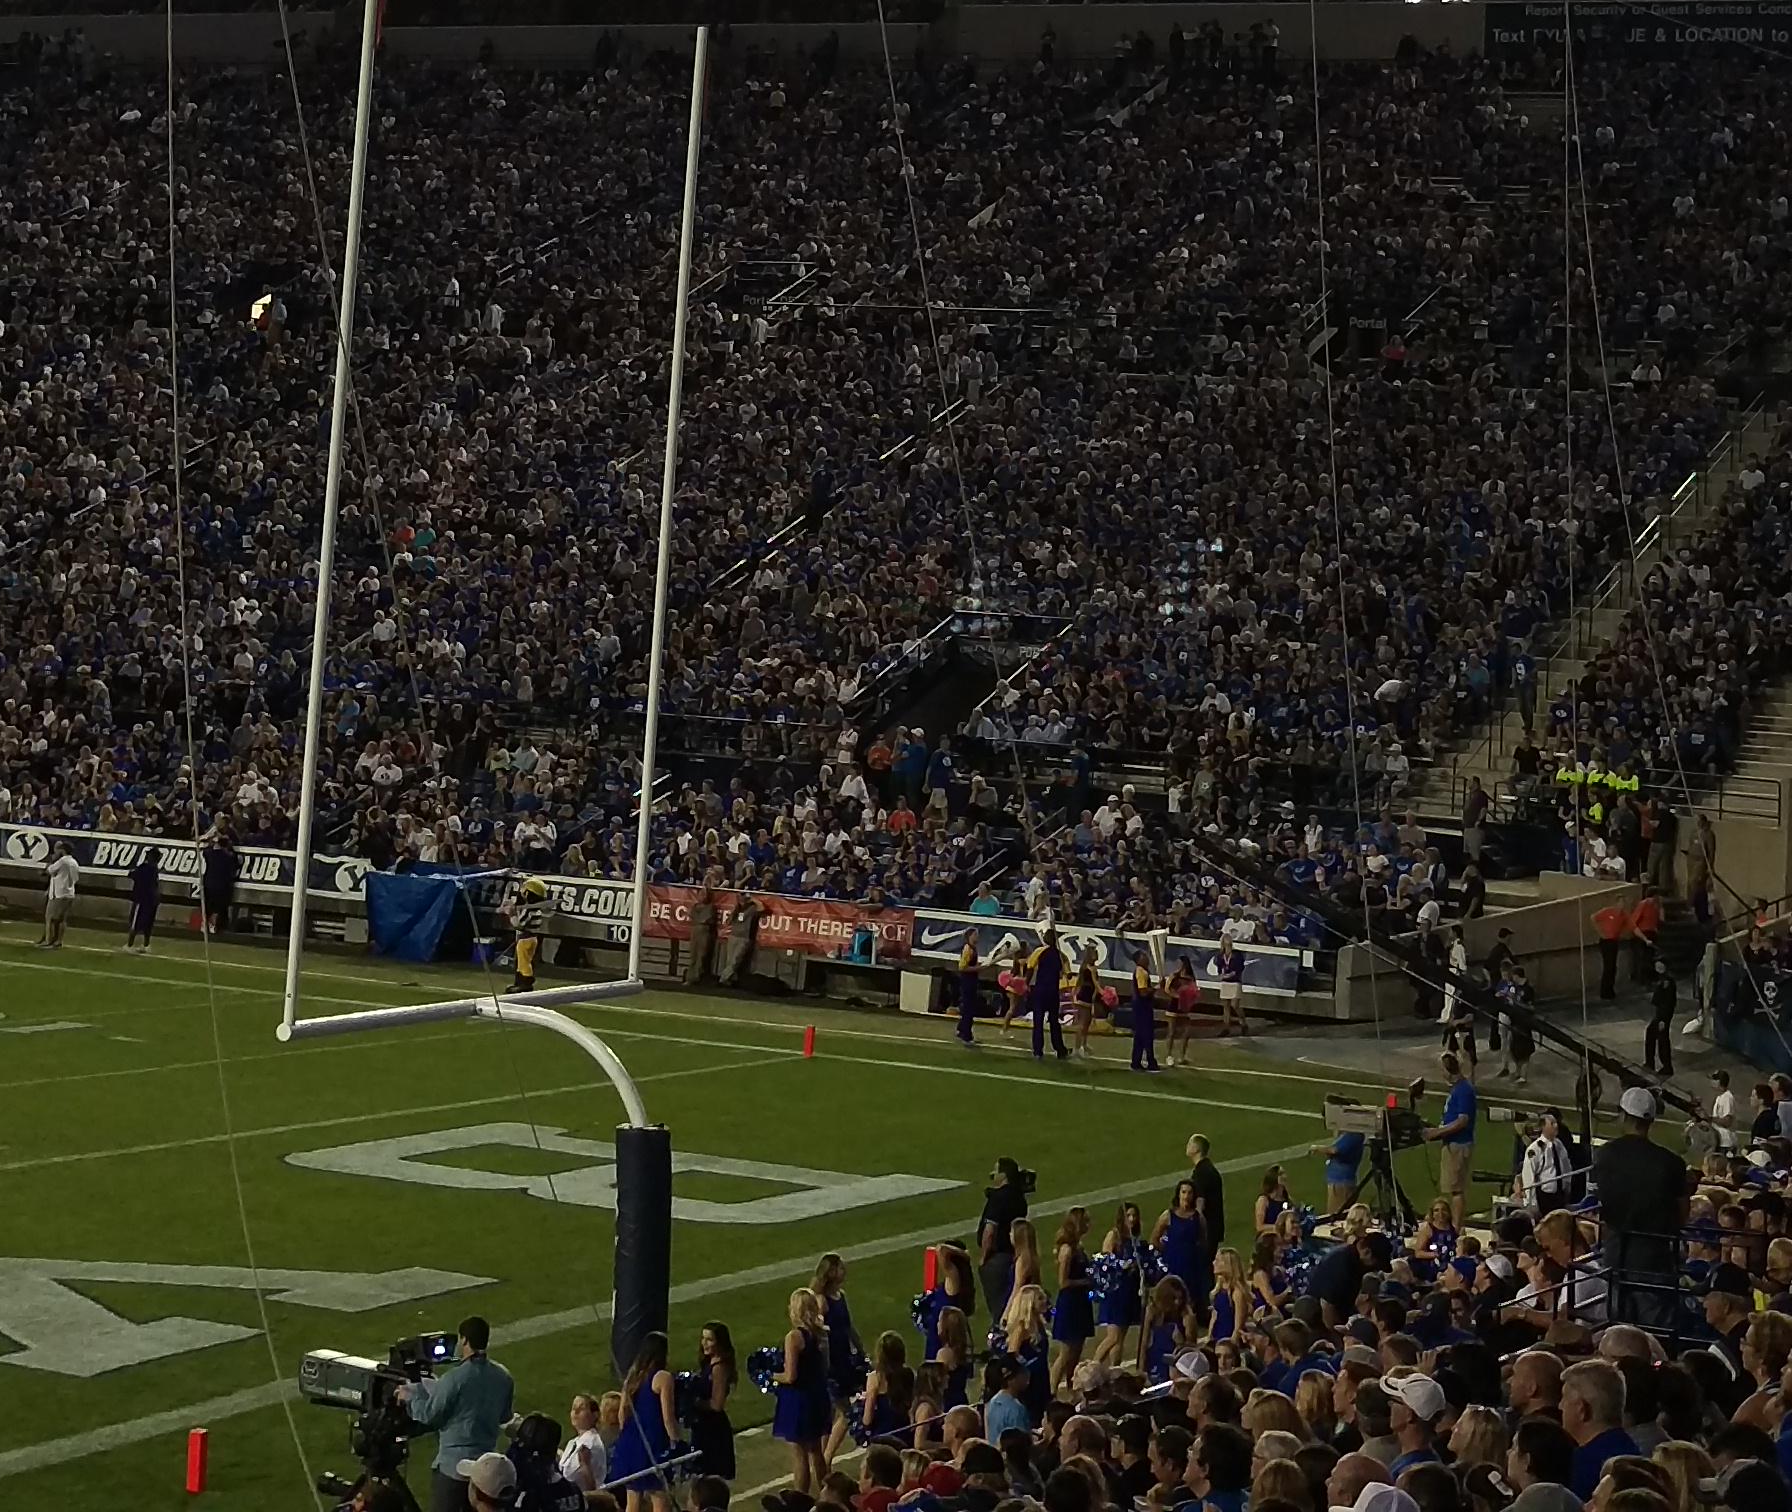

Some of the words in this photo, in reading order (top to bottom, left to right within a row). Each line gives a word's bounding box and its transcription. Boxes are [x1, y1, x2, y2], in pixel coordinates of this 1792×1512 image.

[1526, 5, 1567, 17] Report
[1574, 4, 1626, 17] Security
[1632, 6, 1646, 16] or
[1650, 4, 1688, 17] Guest
[1695, 3, 1752, 15] Services
[1493, 28, 1526, 43] Text
[1655, 28, 1666, 43] &
[1674, 27, 1762, 43] LOCATION
[1771, 28, 1788, 42] to
[1349, 316, 1387, 329] Portal
[92, 840, 134, 867] BYU
[237, 854, 281, 882] LUB
[649, 901, 672, 920] BE
[609, 924, 630, 942] 10
[758, 915, 793, 930] OUT
[797, 917, 853, 939] THERE
